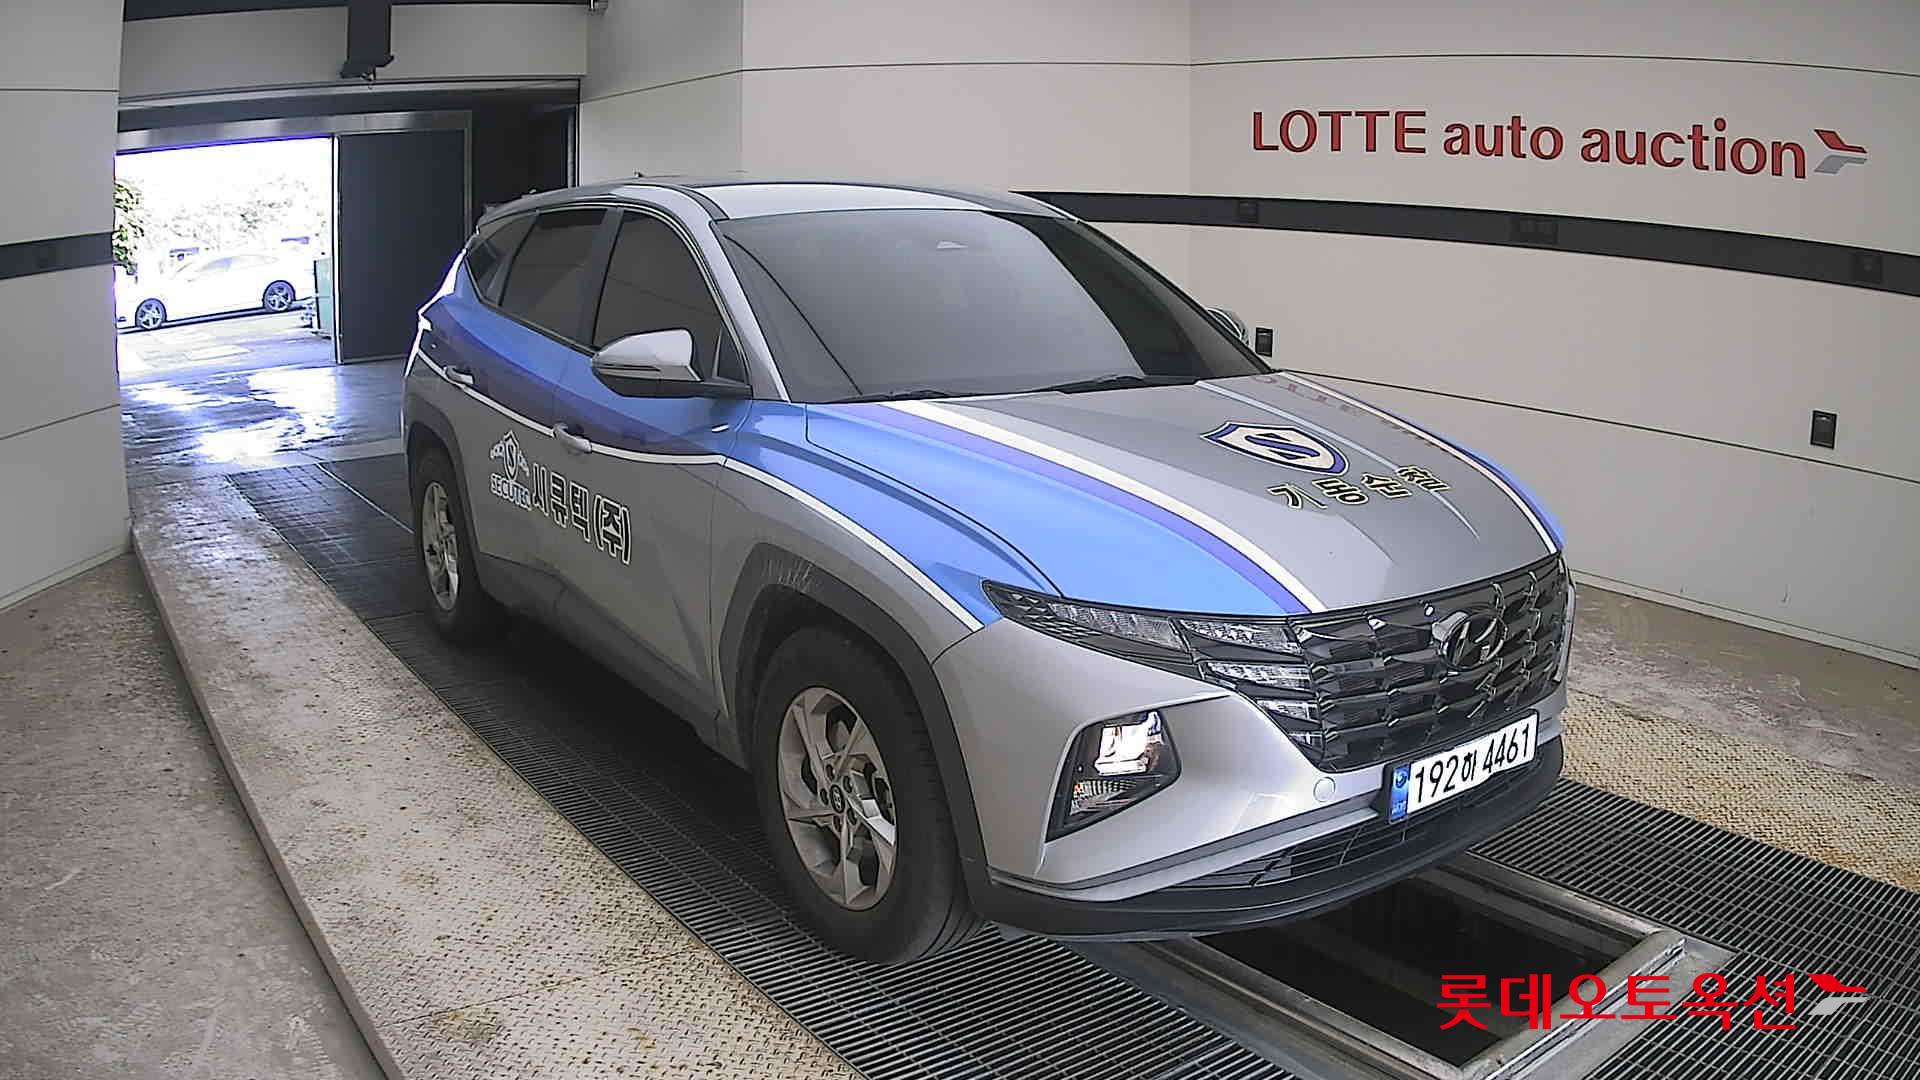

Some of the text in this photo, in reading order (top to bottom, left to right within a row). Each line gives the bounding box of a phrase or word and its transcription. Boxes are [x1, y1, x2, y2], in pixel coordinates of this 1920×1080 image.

[1253, 111, 1807, 179] LOTTE auto auction
[532, 462, 631, 565] 시큐텍(주)
[1415, 723, 1530, 803] 192하 4461
